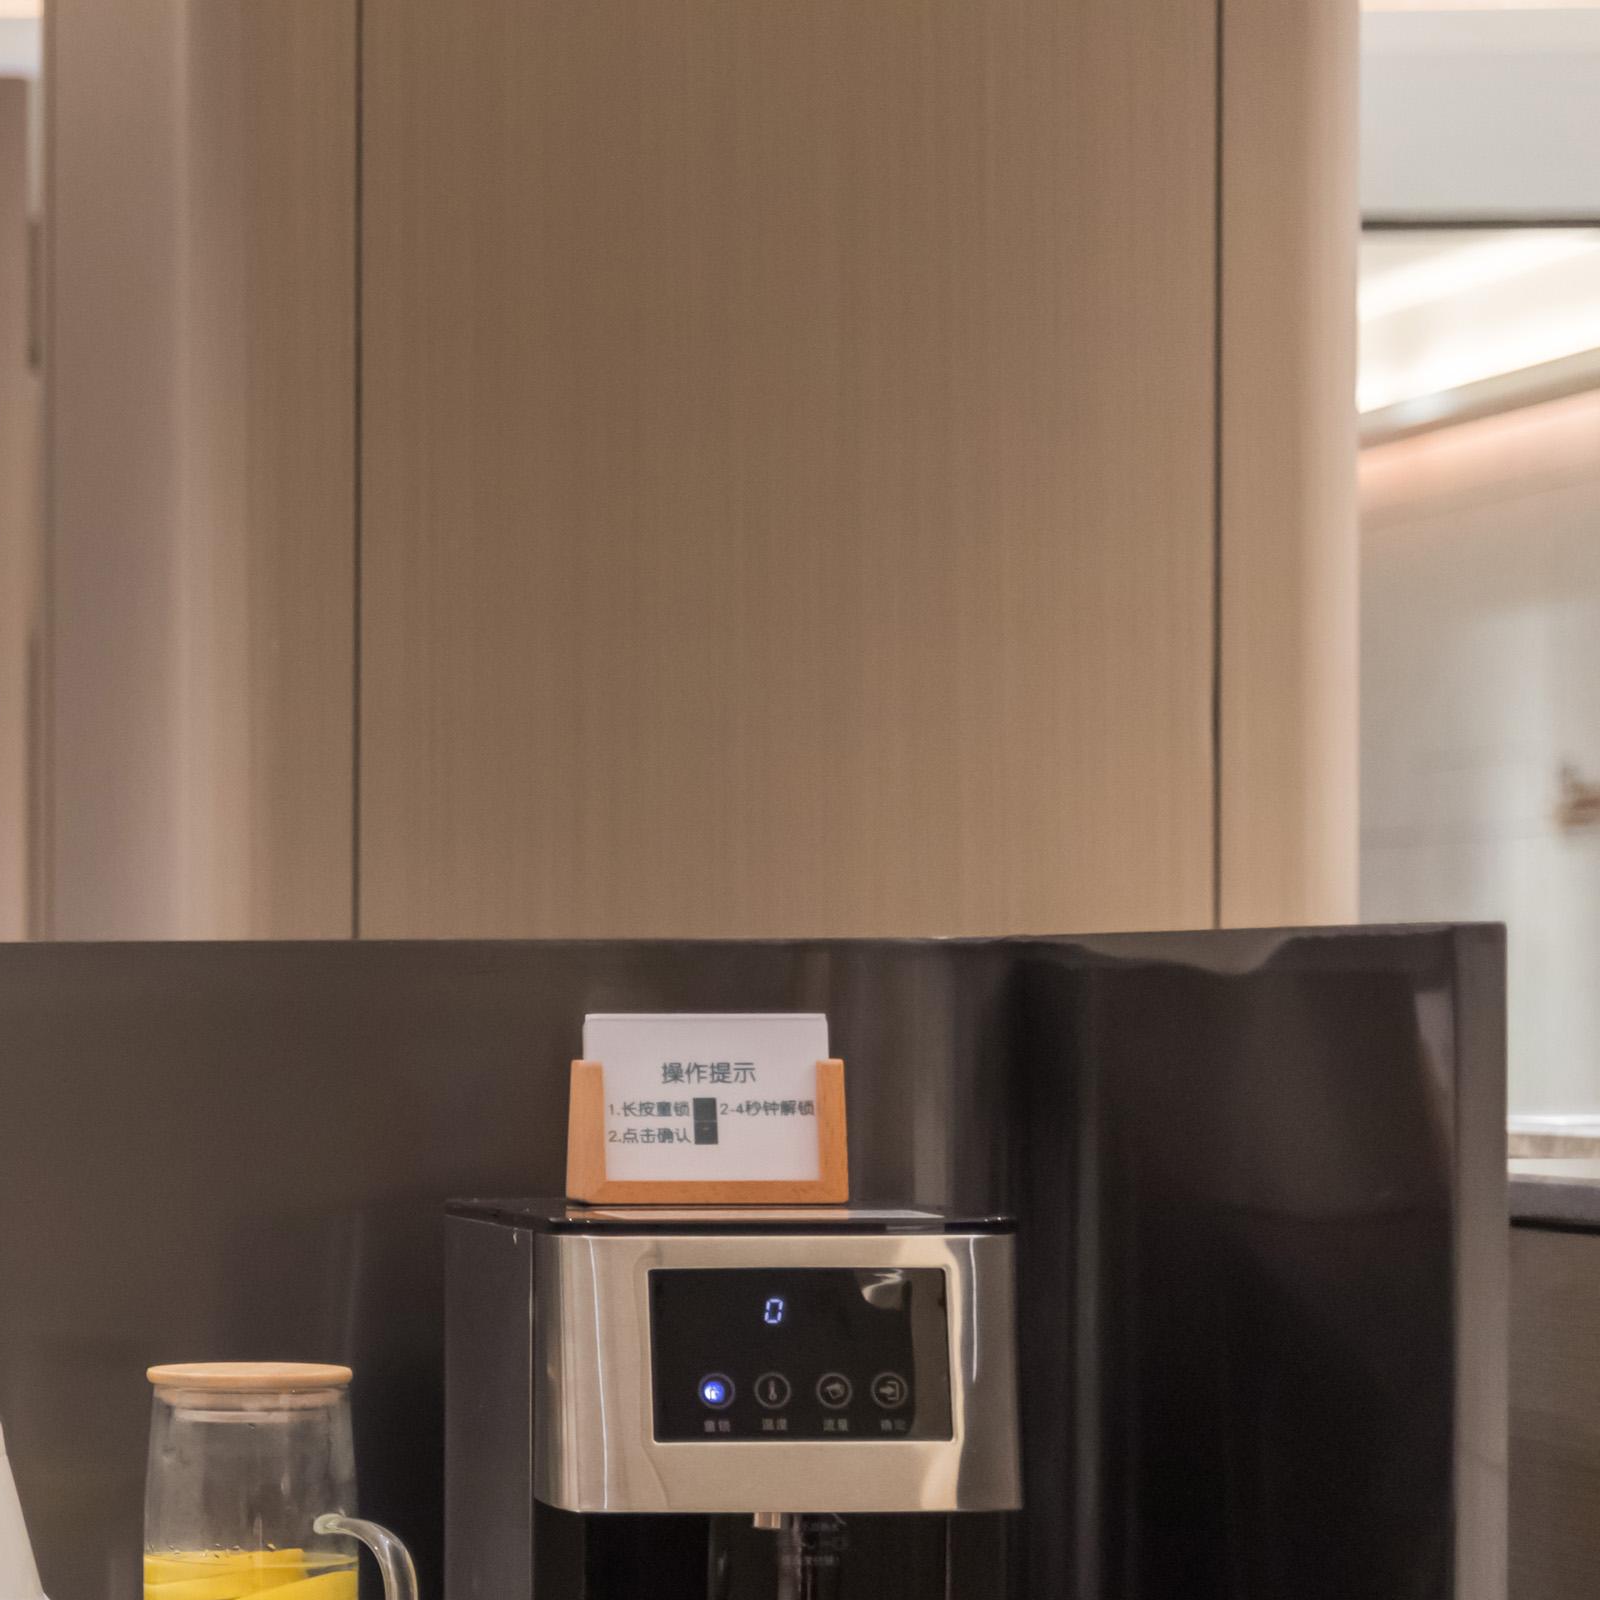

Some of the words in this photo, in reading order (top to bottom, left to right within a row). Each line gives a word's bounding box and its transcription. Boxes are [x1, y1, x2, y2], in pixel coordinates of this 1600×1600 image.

[661, 1062, 756, 1084] 操作提示
[608, 1128, 691, 1143] 2.点击确认
[764, 1298, 784, 1324] 0
